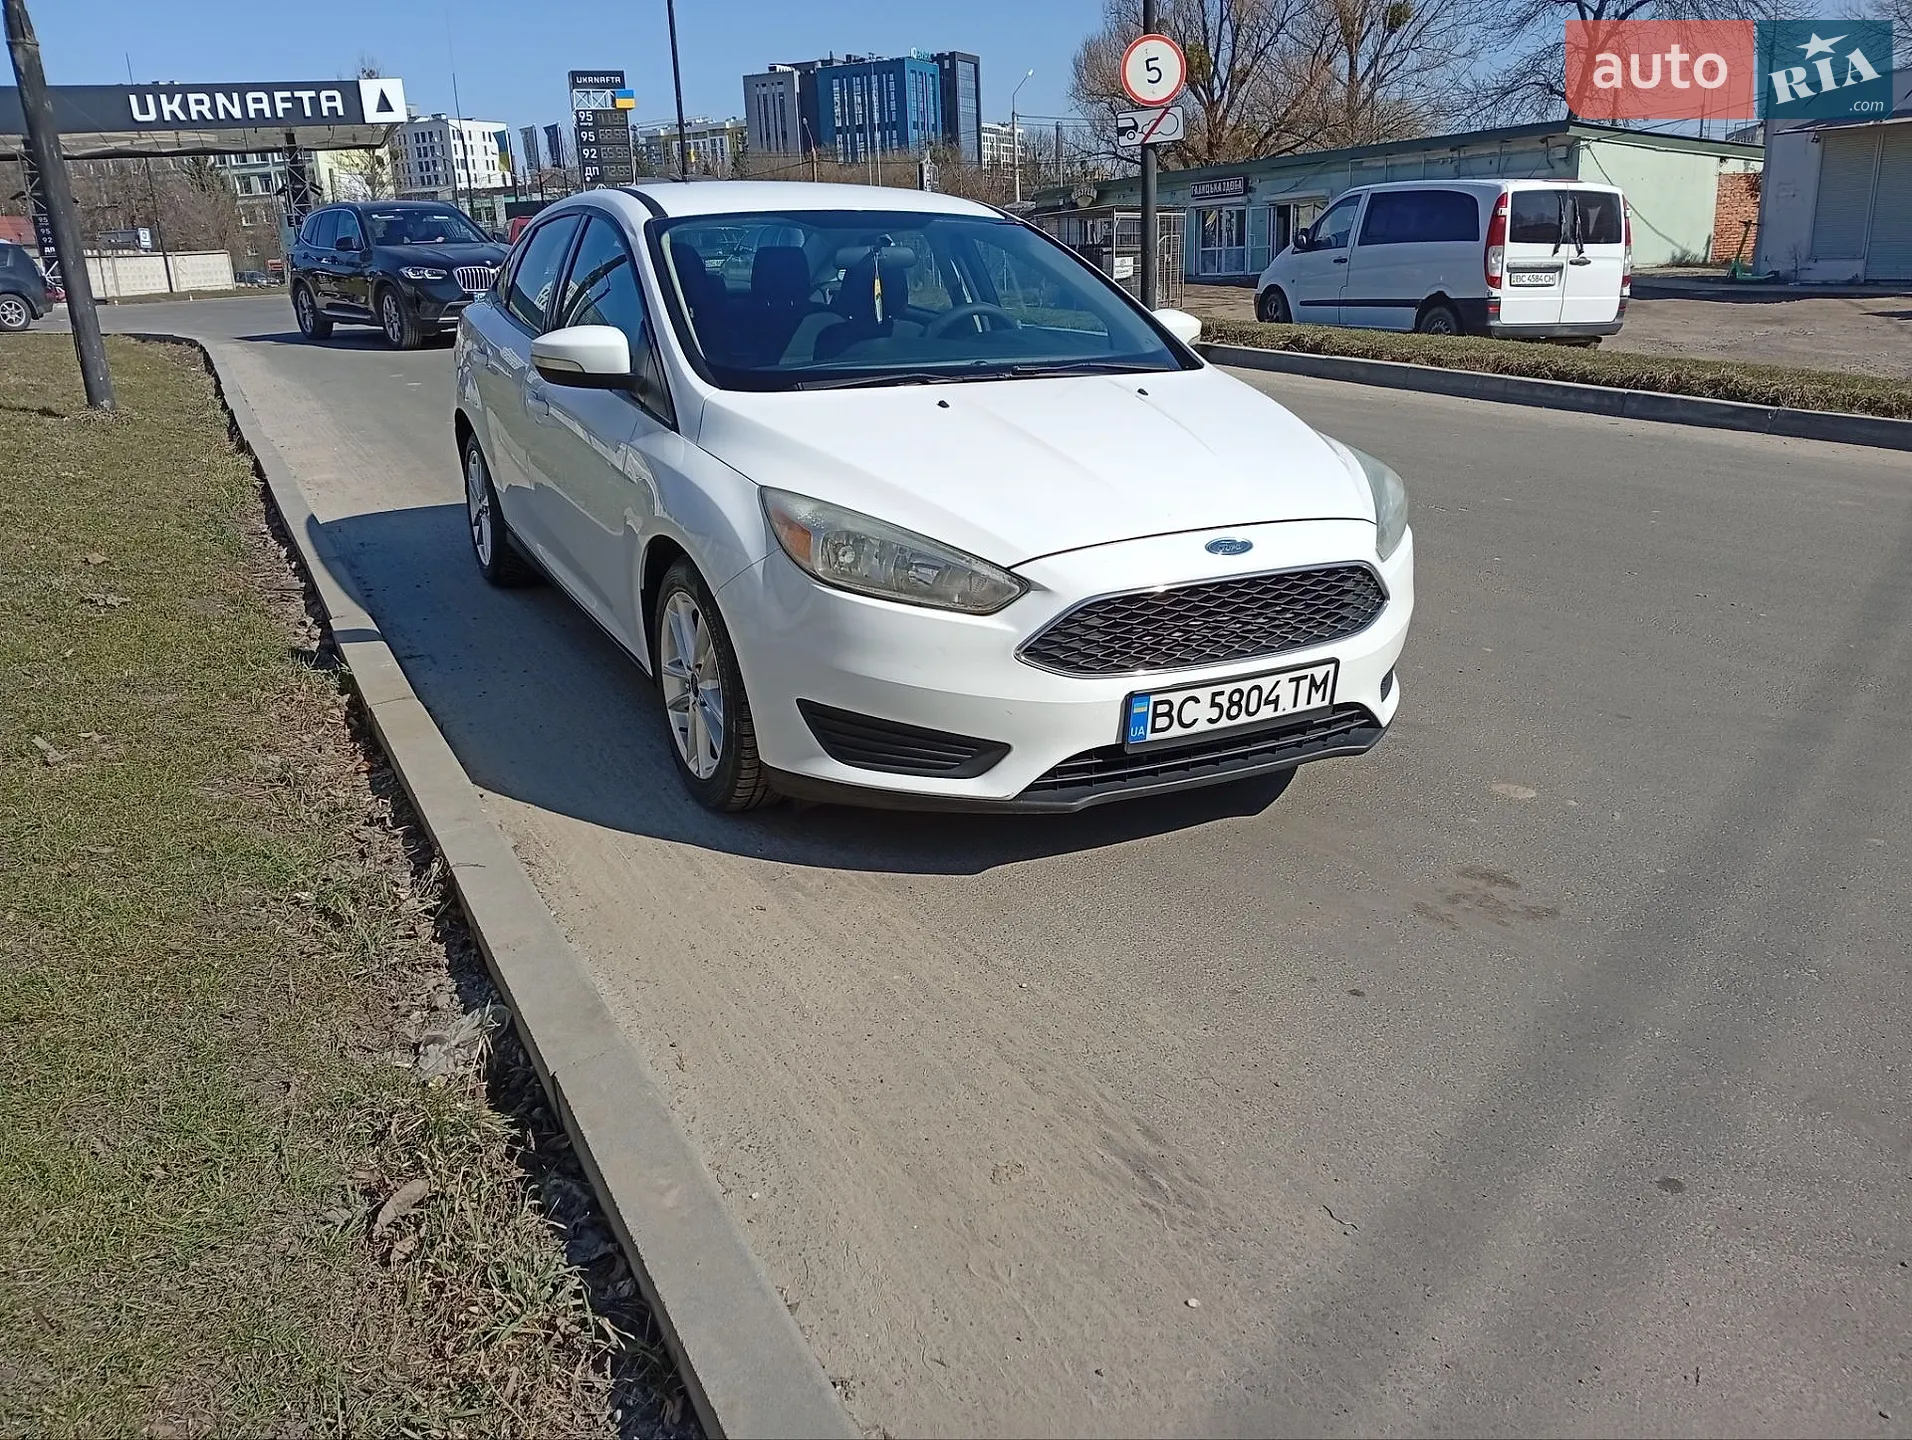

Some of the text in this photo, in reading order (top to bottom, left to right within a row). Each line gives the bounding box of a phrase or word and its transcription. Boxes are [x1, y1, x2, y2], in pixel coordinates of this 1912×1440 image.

[1145, 57, 1163, 84] 5
[576, 76, 621, 84] UKRNAFTA
[128, 90, 344, 122] UKRNAFTA
[578, 111, 593, 121] 95
[581, 131, 595, 142] 95
[582, 148, 597, 159] 92
[584, 166, 600, 177] ДП
[1544, 274, 1554, 283] CH
[1130, 670, 1330, 737] UA BC 5804 TM
